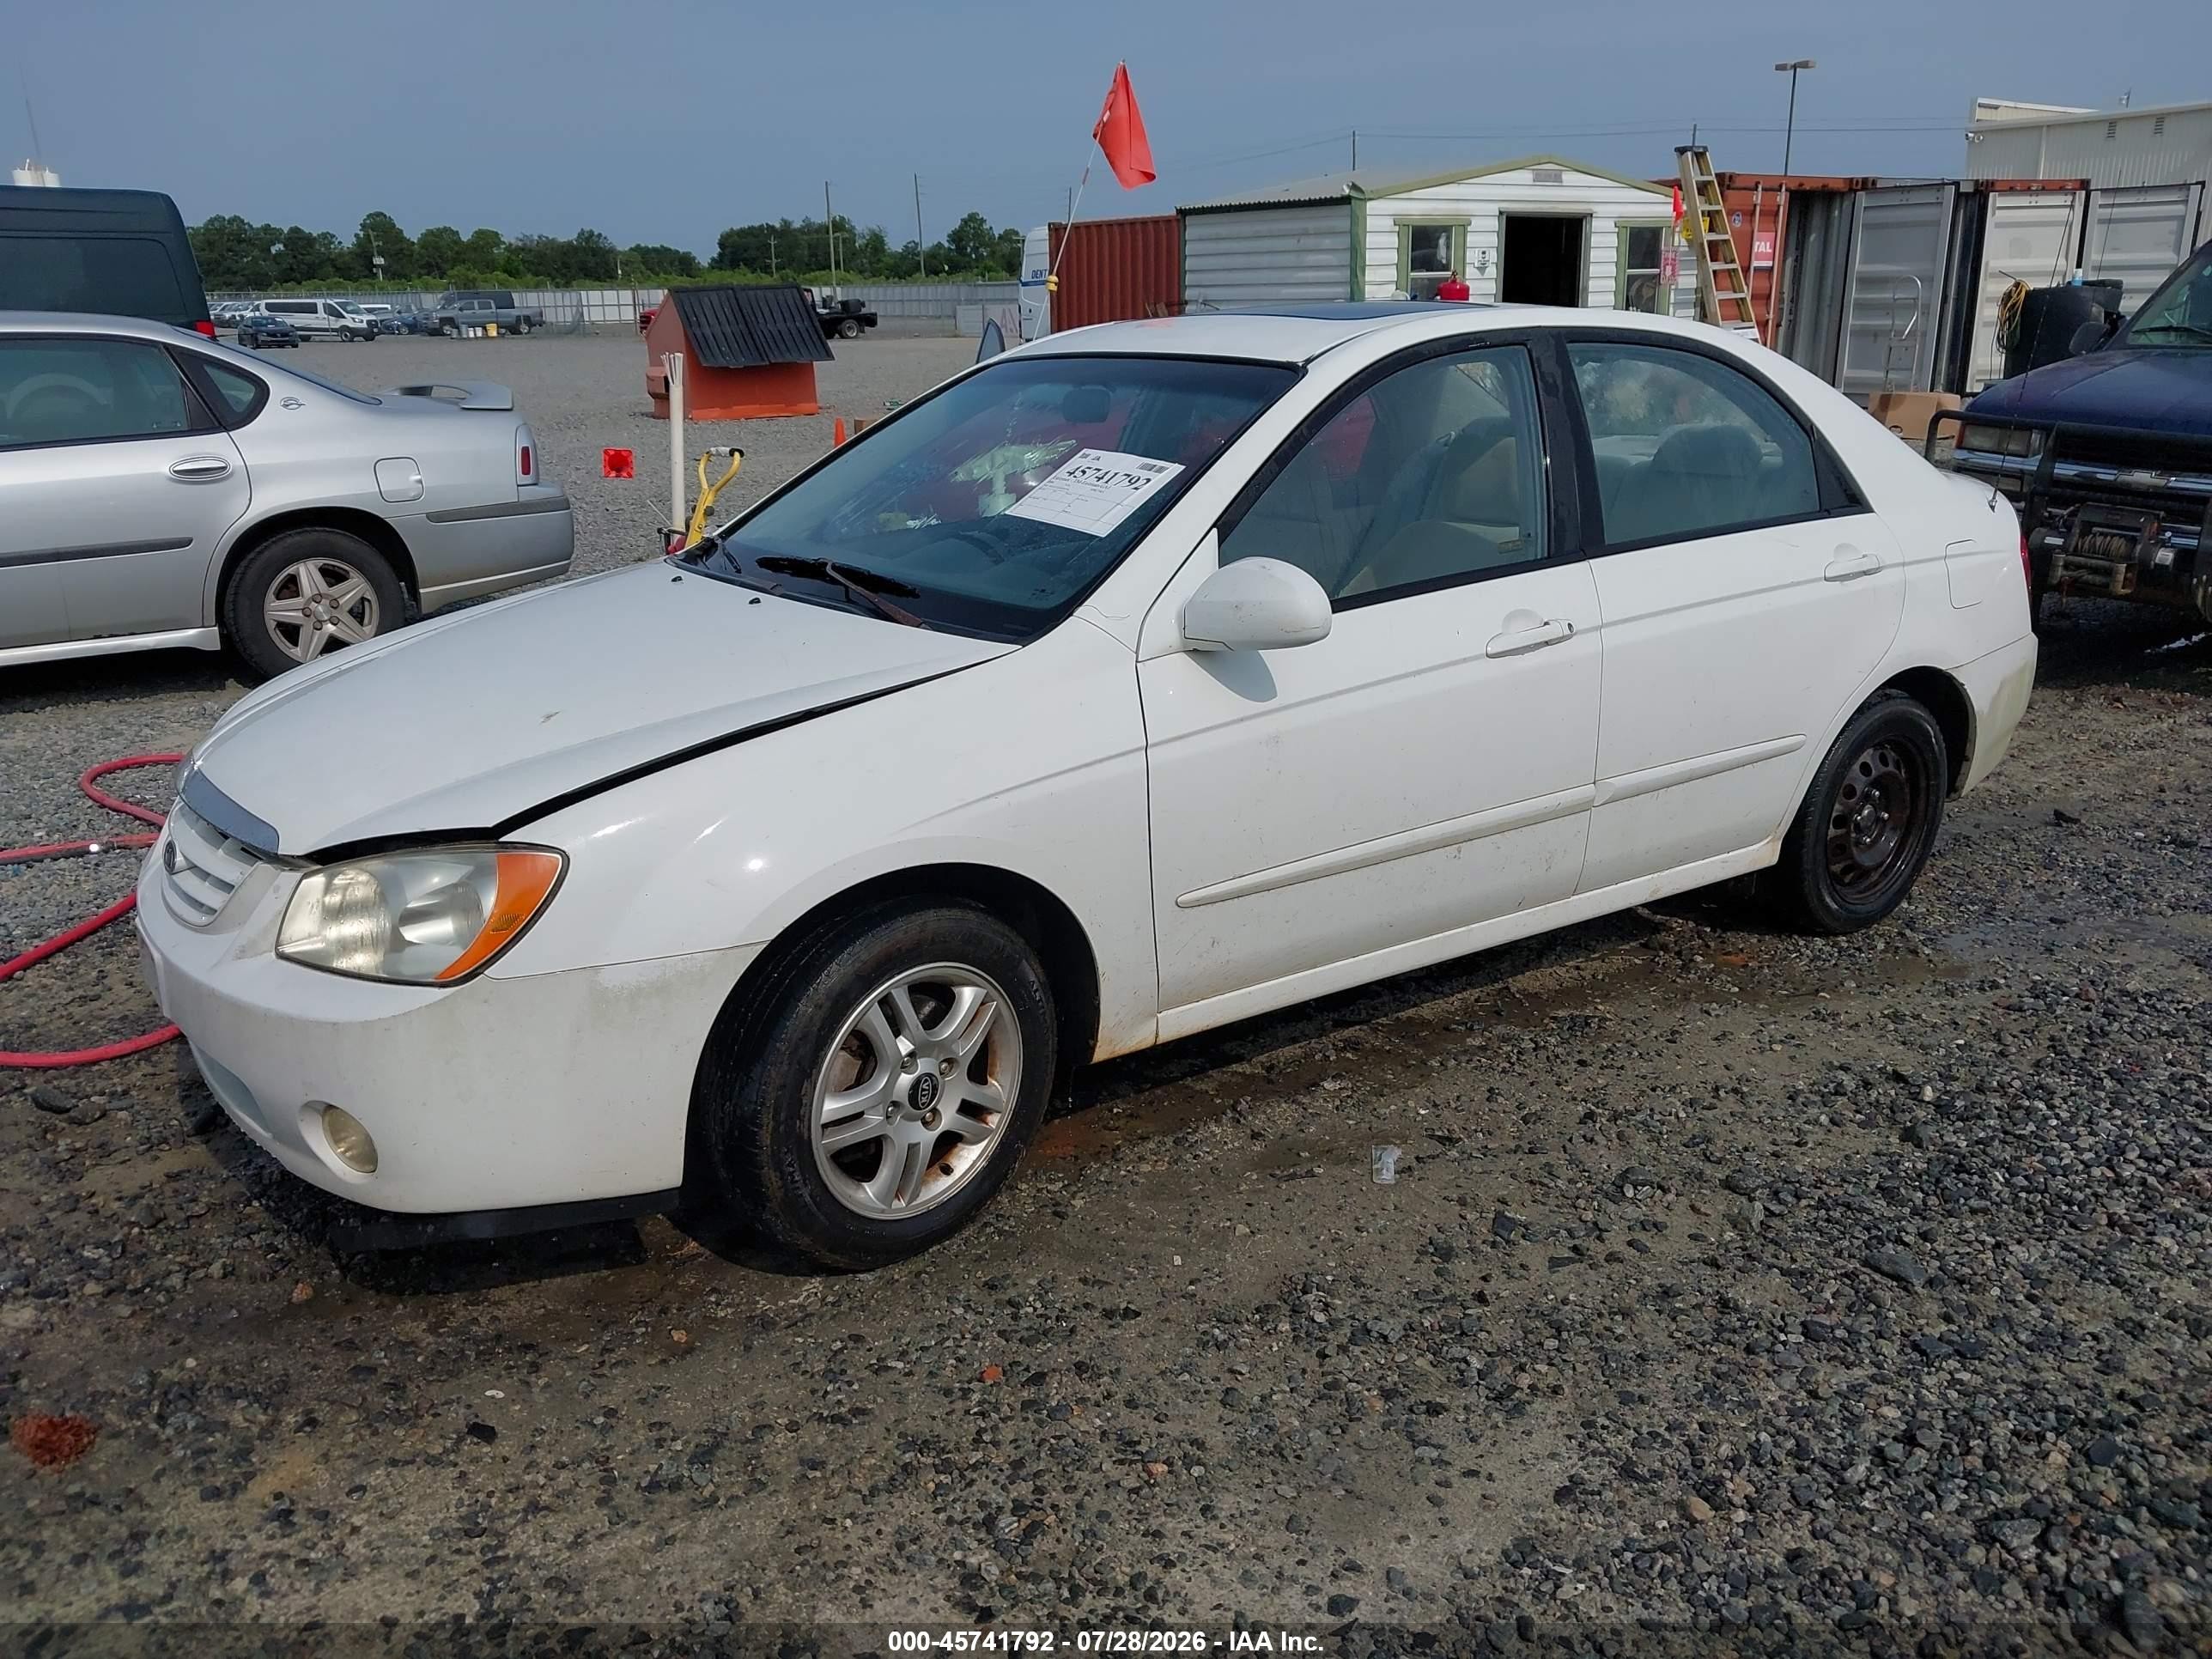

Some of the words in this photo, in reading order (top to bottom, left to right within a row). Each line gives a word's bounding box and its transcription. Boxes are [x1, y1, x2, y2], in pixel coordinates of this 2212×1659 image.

[1754, 241, 1772, 252] TAL
[1031, 269, 1048, 279] DENT
[1066, 465, 1152, 491] 45741792
[920, 1081, 930, 1103] KIA
